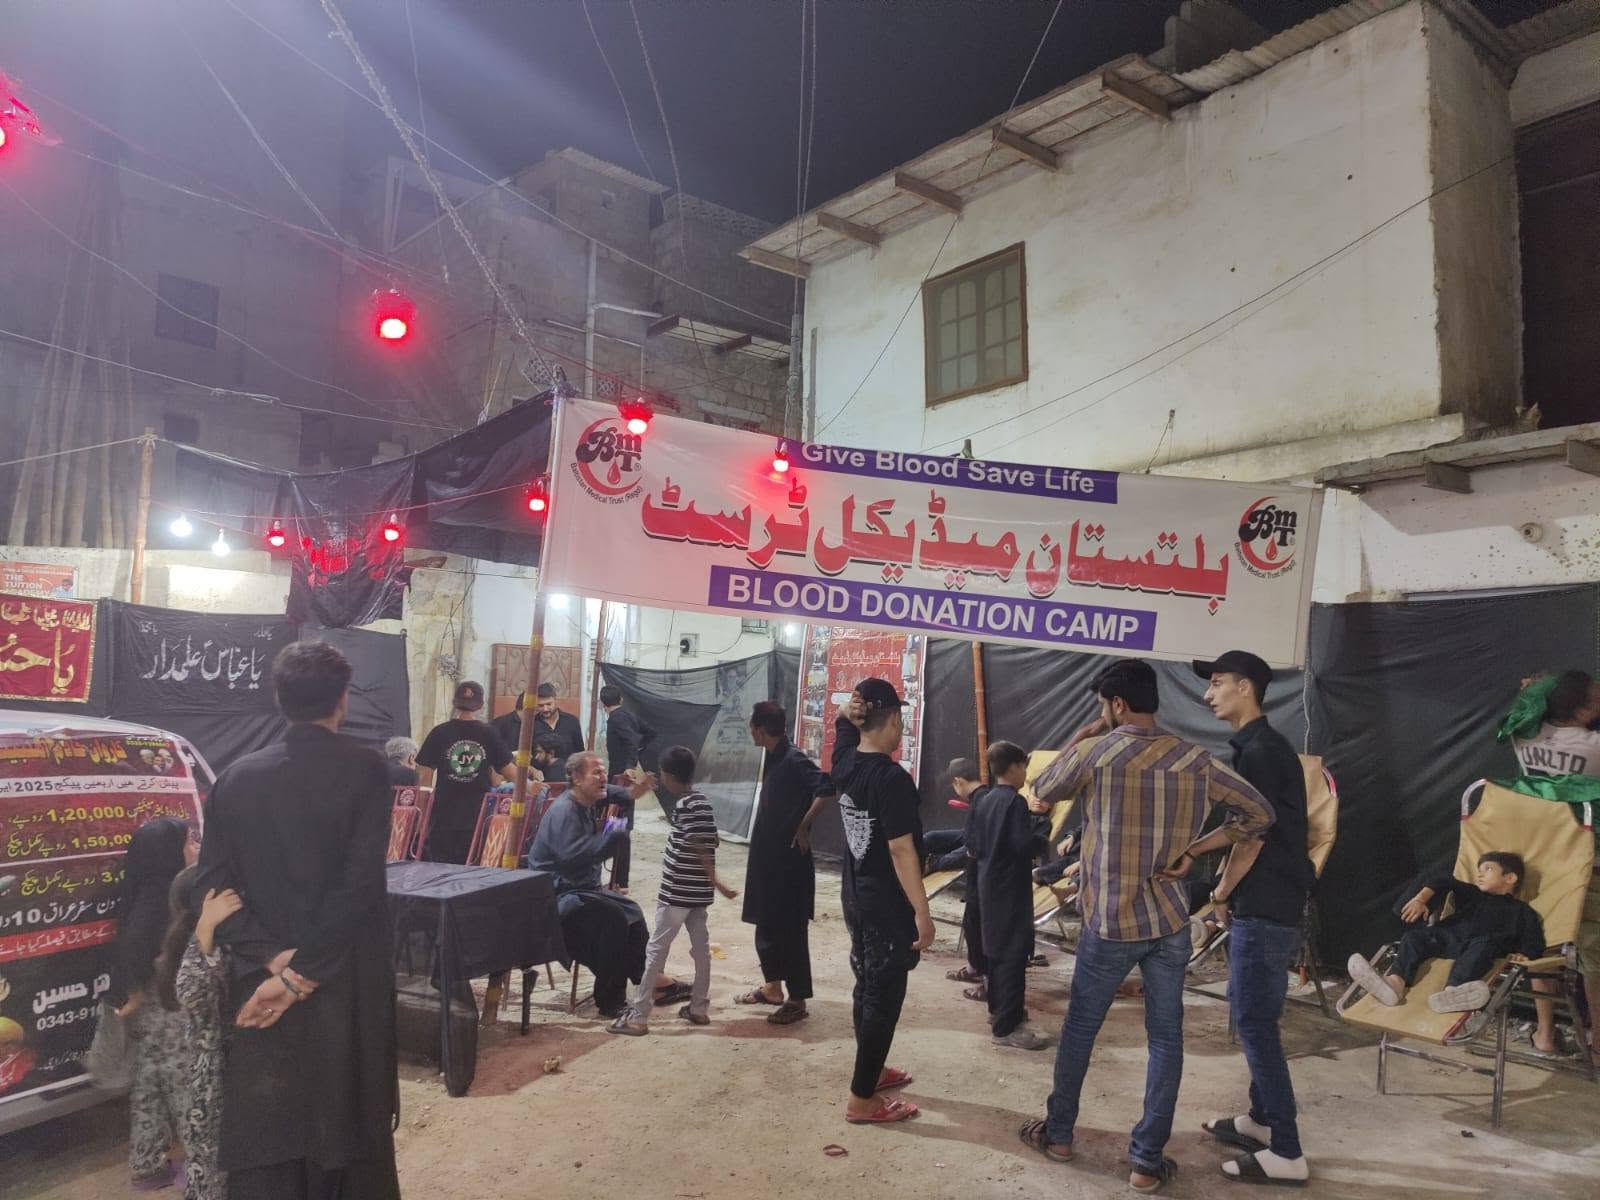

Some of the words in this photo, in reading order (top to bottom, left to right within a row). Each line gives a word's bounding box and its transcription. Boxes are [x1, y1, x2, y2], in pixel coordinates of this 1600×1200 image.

[801, 442, 866, 467] Give
[876, 451, 959, 478] Blood
[967, 460, 1035, 487] Save
[1045, 470, 1095, 494] Life
[586, 487, 608, 504] Medical
[609, 496, 625, 505] Trust
[641, 476, 810, 570] ٹرسٹ
[813, 488, 1021, 591] میڈیکل
[4, 573, 25, 582] THE
[1025, 518, 1229, 616] بلتستان
[727, 574, 850, 614] BLOOD
[860, 589, 1036, 633] DONATION
[1045, 608, 1140, 642] CAMP
[458, 754, 475, 765] JY
[1520, 745, 1588, 775] UNLTD
[14, 780, 54, 793] 2025
[47, 806, 125, 824] 1,20,000
[71, 833, 133, 850] 1,50,00
[11, 908, 41, 926] 10
[33, 981, 88, 1014] حسین
